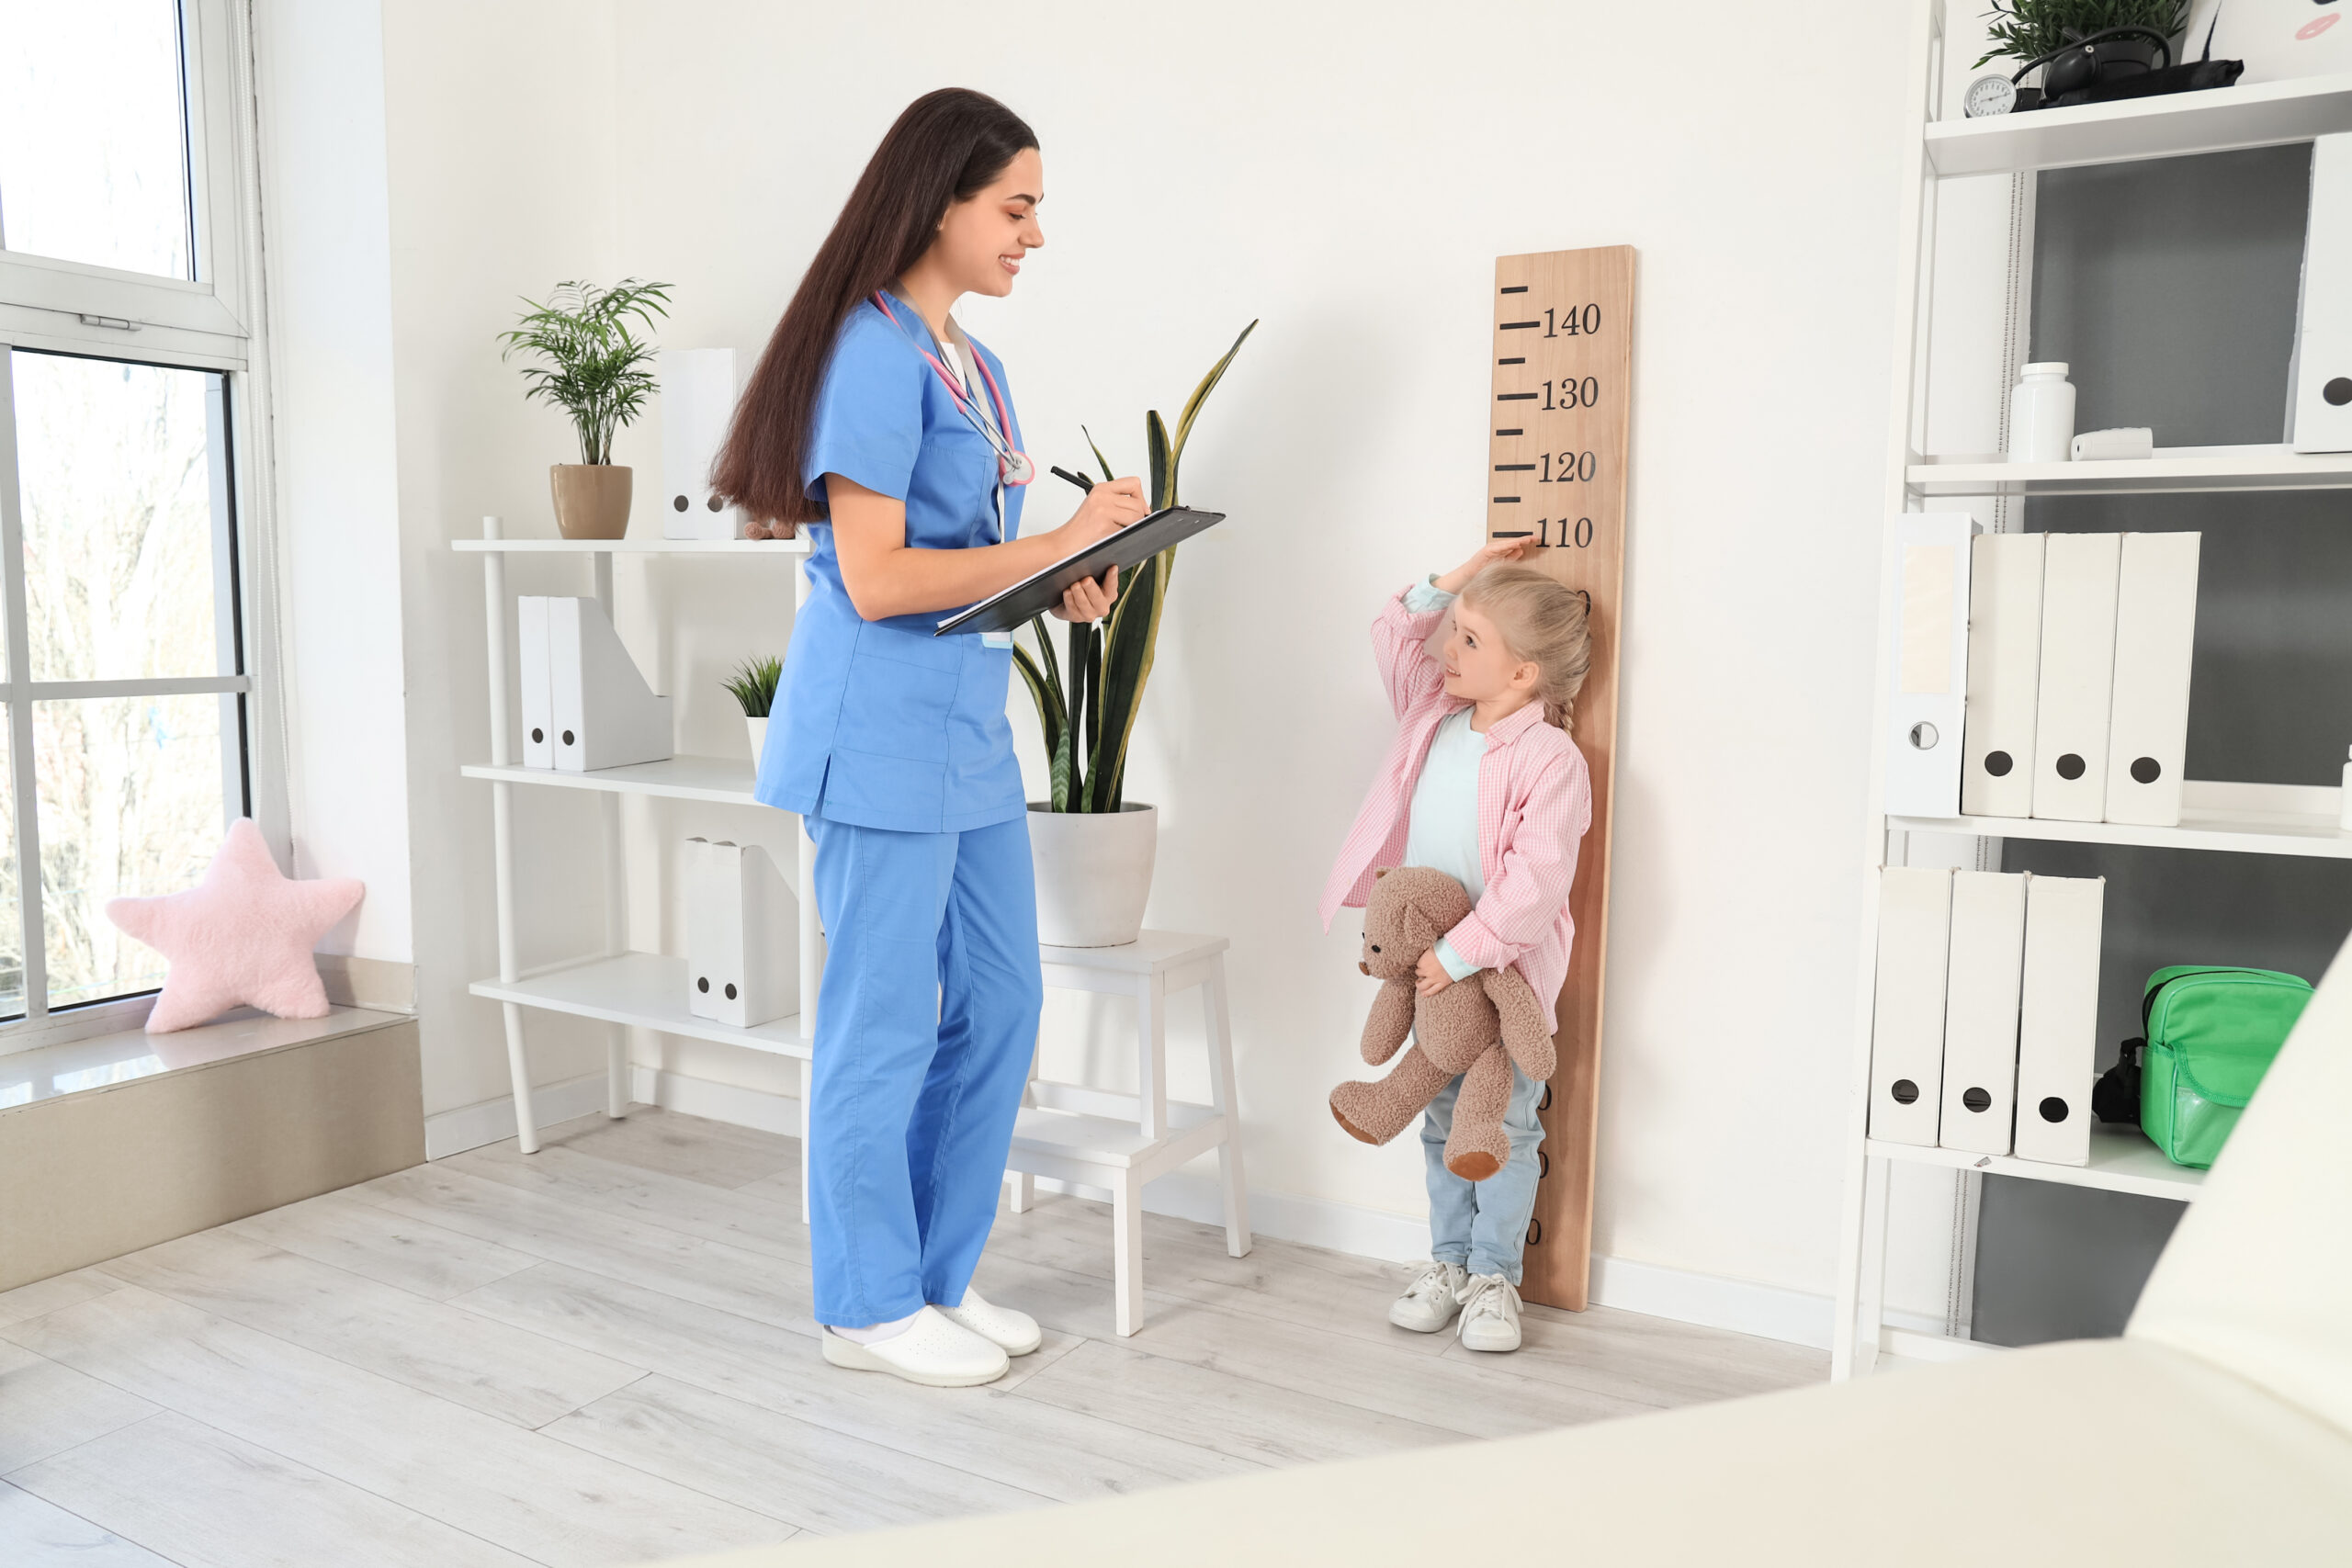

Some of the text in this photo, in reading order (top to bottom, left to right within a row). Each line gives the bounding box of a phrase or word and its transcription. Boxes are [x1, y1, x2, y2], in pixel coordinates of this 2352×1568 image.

[1544, 303, 1600, 338] 140
[1542, 376, 1599, 411] 130
[1538, 451, 1596, 483] 120
[1535, 517, 1593, 548] 110
[1525, 1218, 1542, 1246] 0
